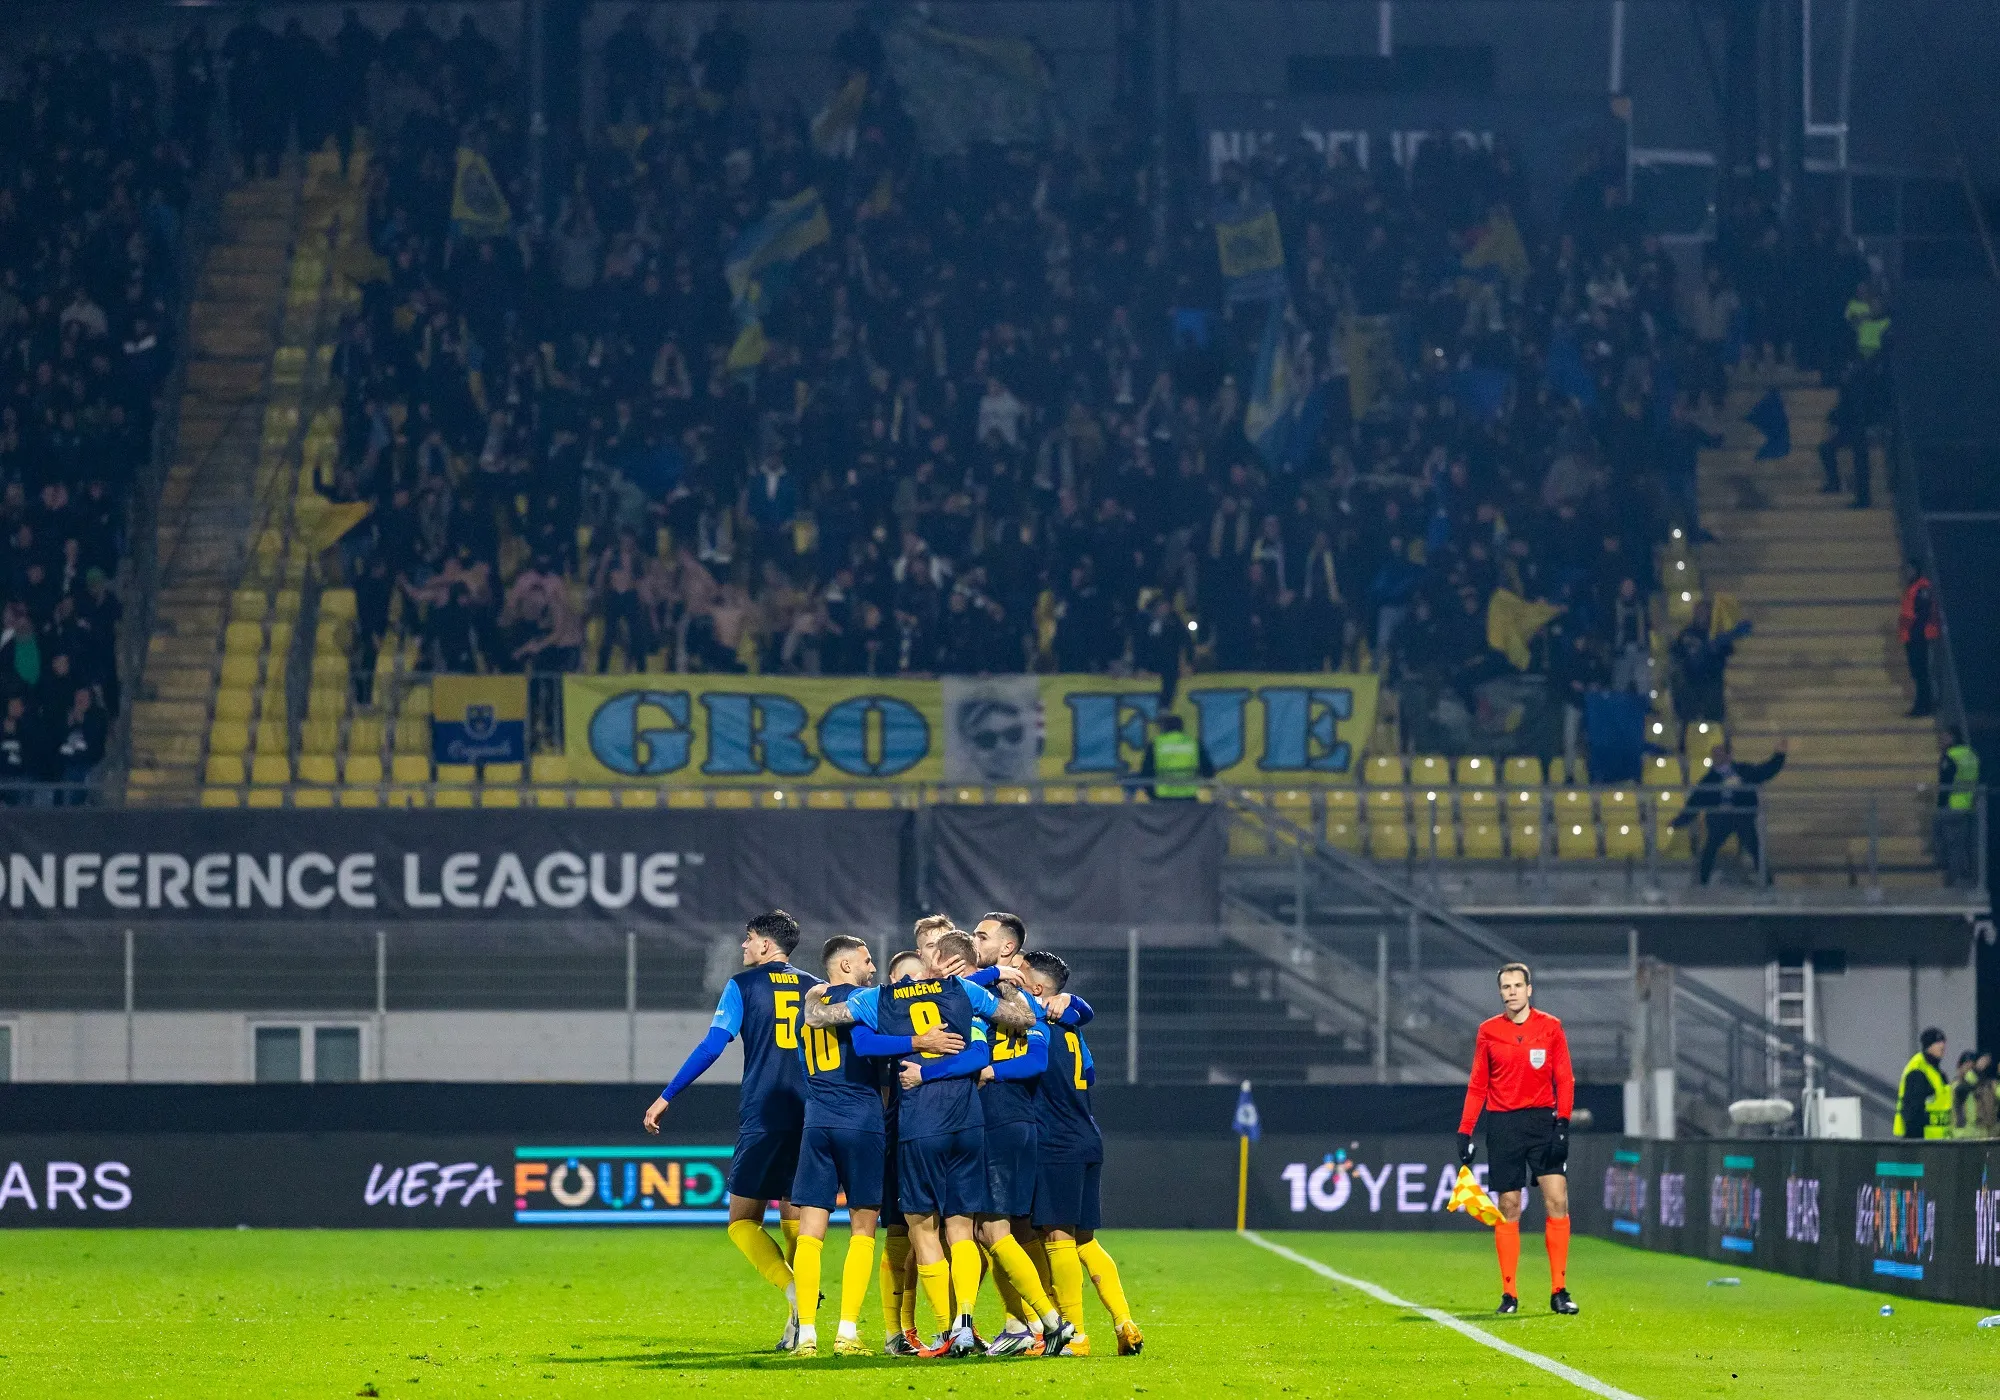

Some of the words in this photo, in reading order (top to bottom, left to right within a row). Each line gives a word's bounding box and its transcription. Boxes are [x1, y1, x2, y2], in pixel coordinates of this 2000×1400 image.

[588, 690, 930, 777] GRO
[0, 853, 377, 908] NFERENCE
[774, 991, 800, 1049] 5
[801, 1023, 841, 1076] 10
[0, 1161, 132, 1211] ARS
[364, 1161, 502, 1207] UEFA
[1281, 1158, 1351, 1212] 10
